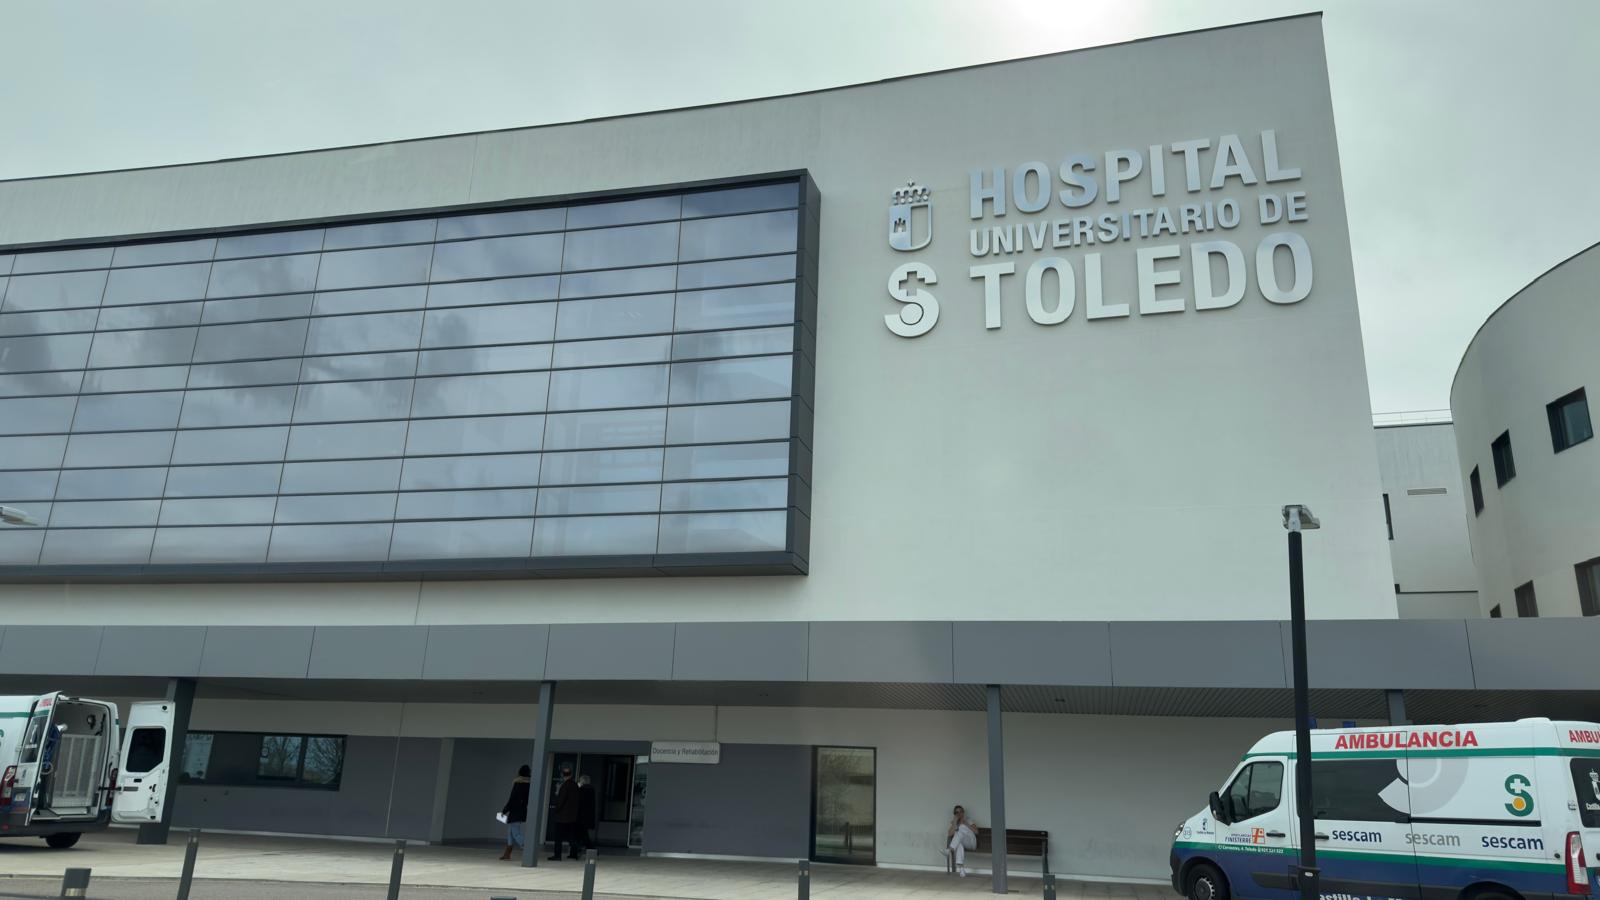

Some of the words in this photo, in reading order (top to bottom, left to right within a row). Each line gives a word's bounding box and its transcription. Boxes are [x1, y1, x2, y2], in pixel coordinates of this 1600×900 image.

[968, 129, 1302, 219] HOSPITAL
[969, 197, 1241, 257] UNIVERSITARIO
[1258, 191, 1309, 225] DE
[969, 232, 1314, 330] TOLEDO
[1335, 730, 1478, 750] AMBULANCIA
[1568, 729, 1600, 744] AMBU
[1331, 828, 1382, 844] sescam
[1404, 831, 1461, 847] sescam
[1481, 834, 1544, 851] sescam
